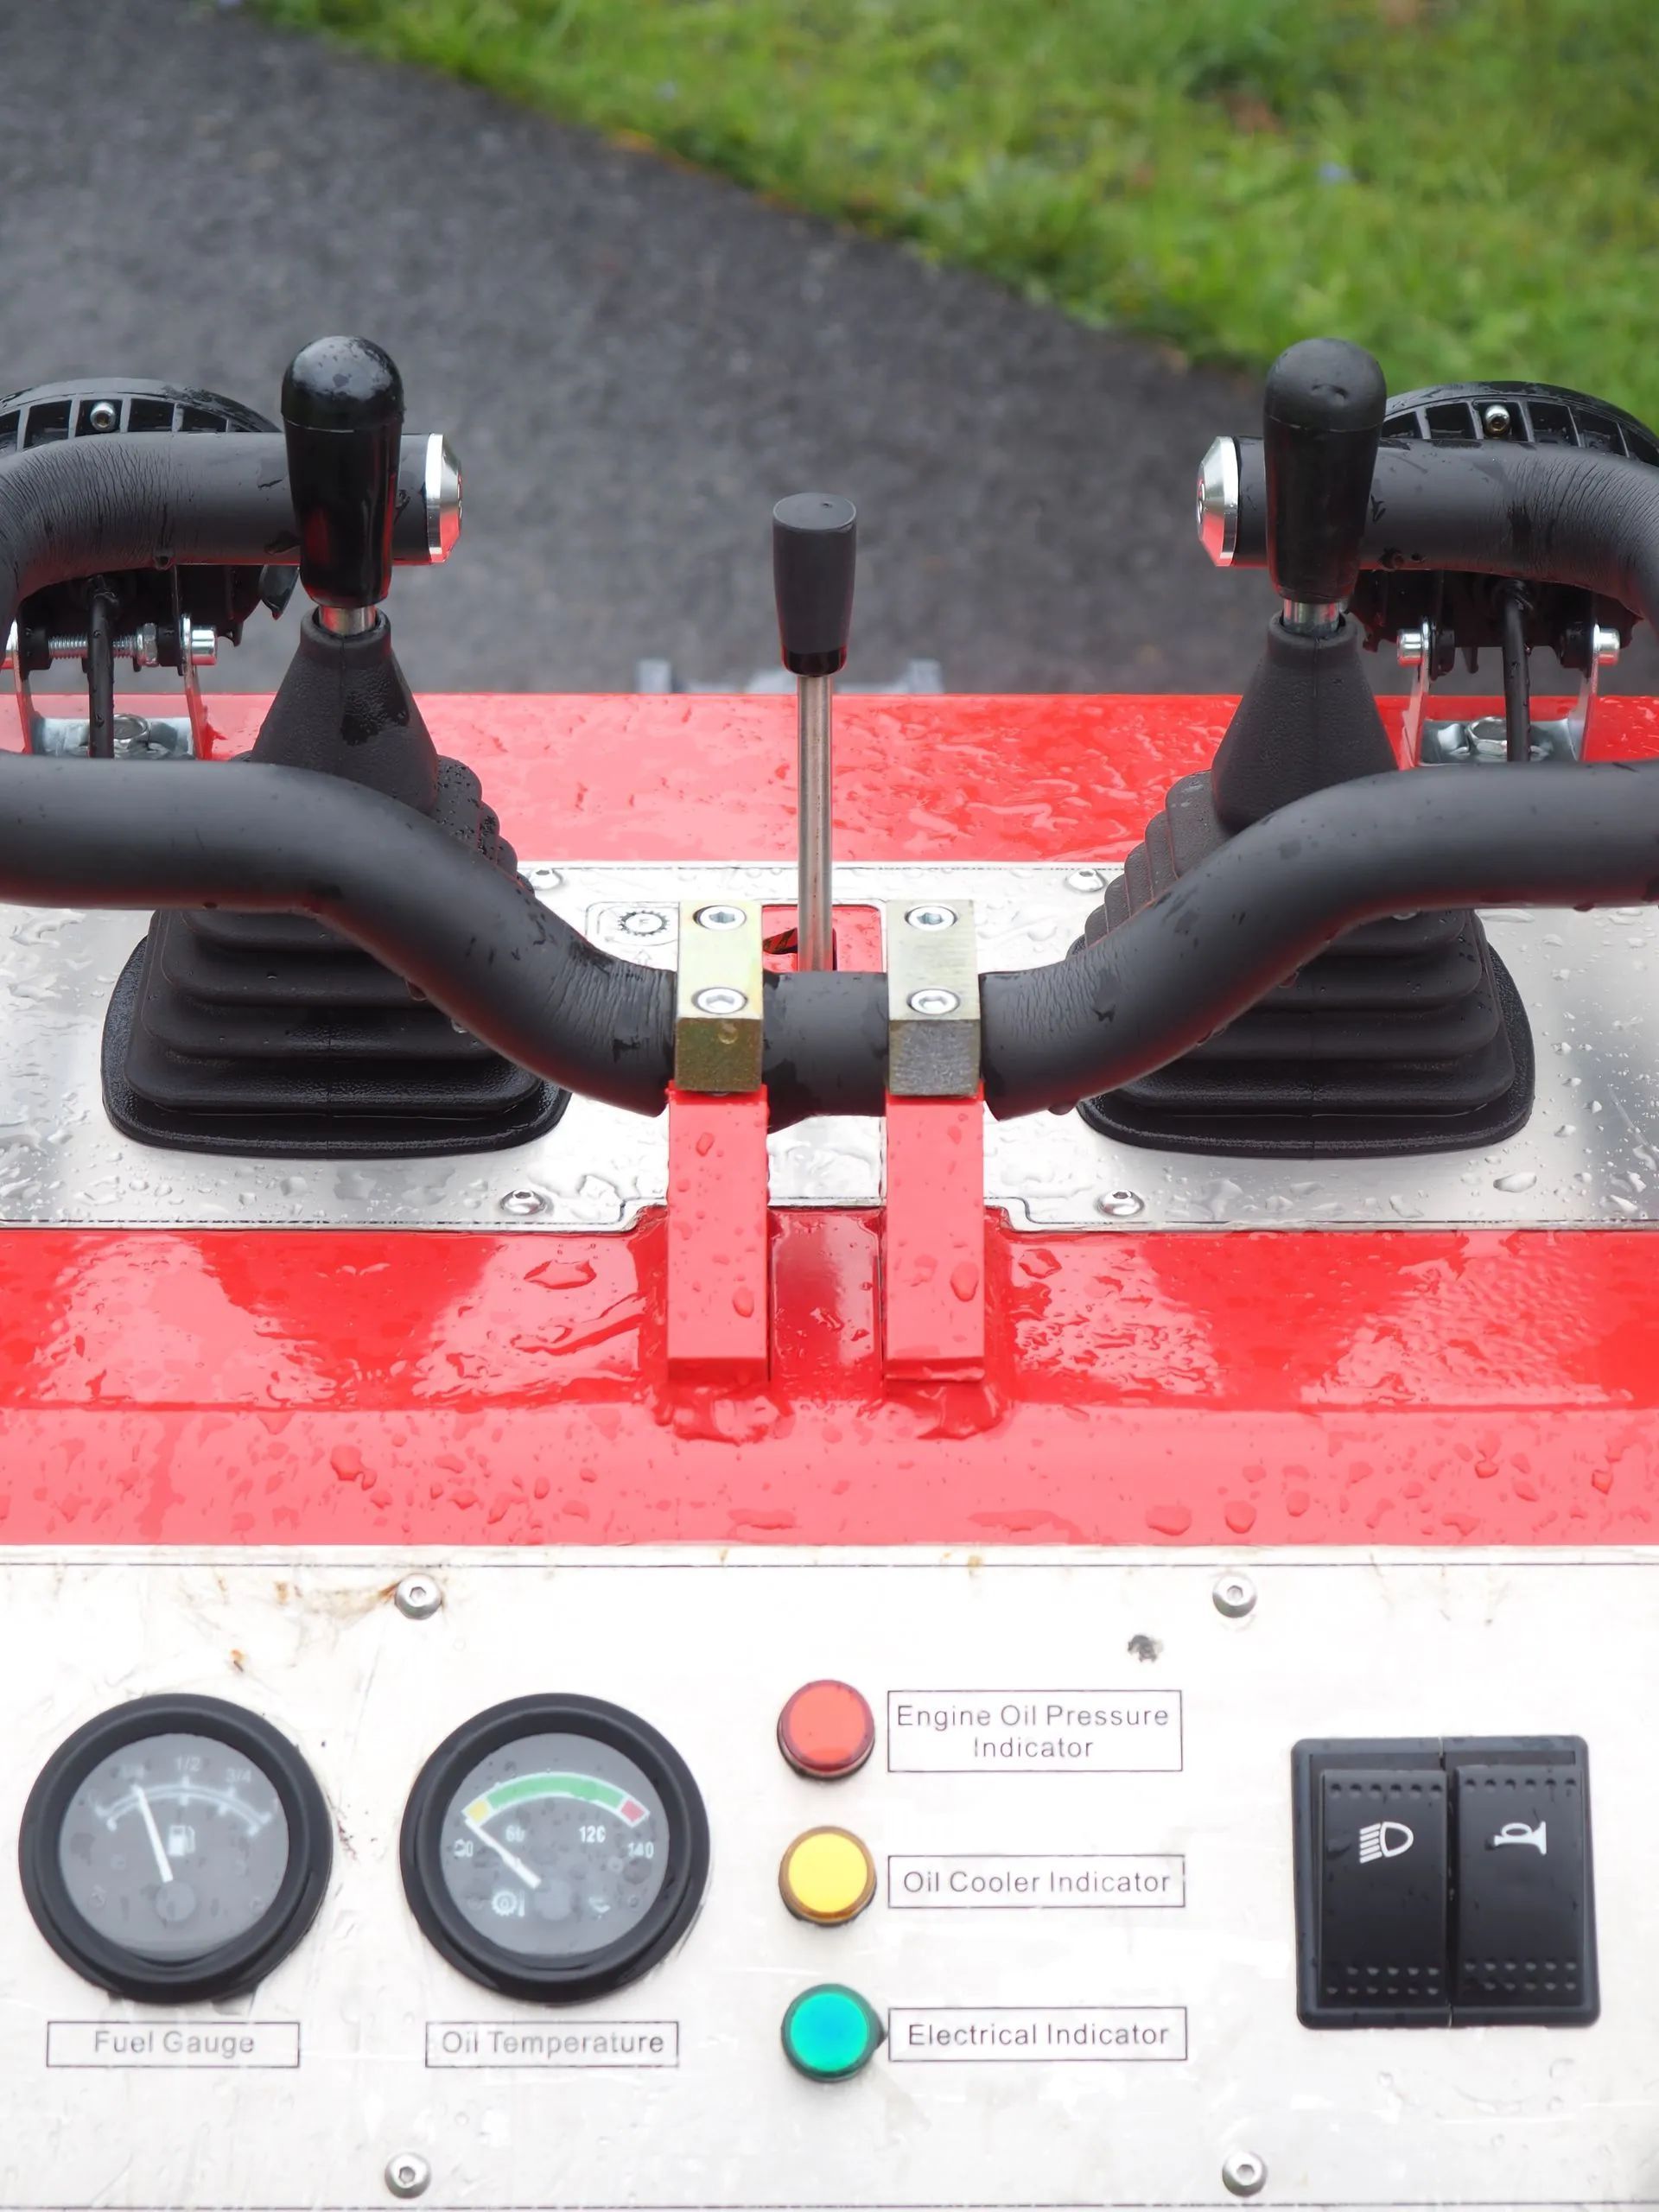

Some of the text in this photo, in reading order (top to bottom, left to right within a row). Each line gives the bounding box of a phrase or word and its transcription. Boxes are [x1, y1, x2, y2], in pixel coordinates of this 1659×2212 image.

[897, 1704, 1169, 1732] Engine Oil Pressure
[974, 1736, 1094, 1758] Indicator
[176, 1756, 200, 1772] 1/2
[627, 1841, 655, 1859] 140
[903, 1871, 1172, 1894] Oil Cooler Indicator
[94, 2030, 255, 2060] Fuel Gauge
[442, 2030, 664, 2060] Oil Temperature
[908, 2023, 1170, 2047] Electrical Indicator
